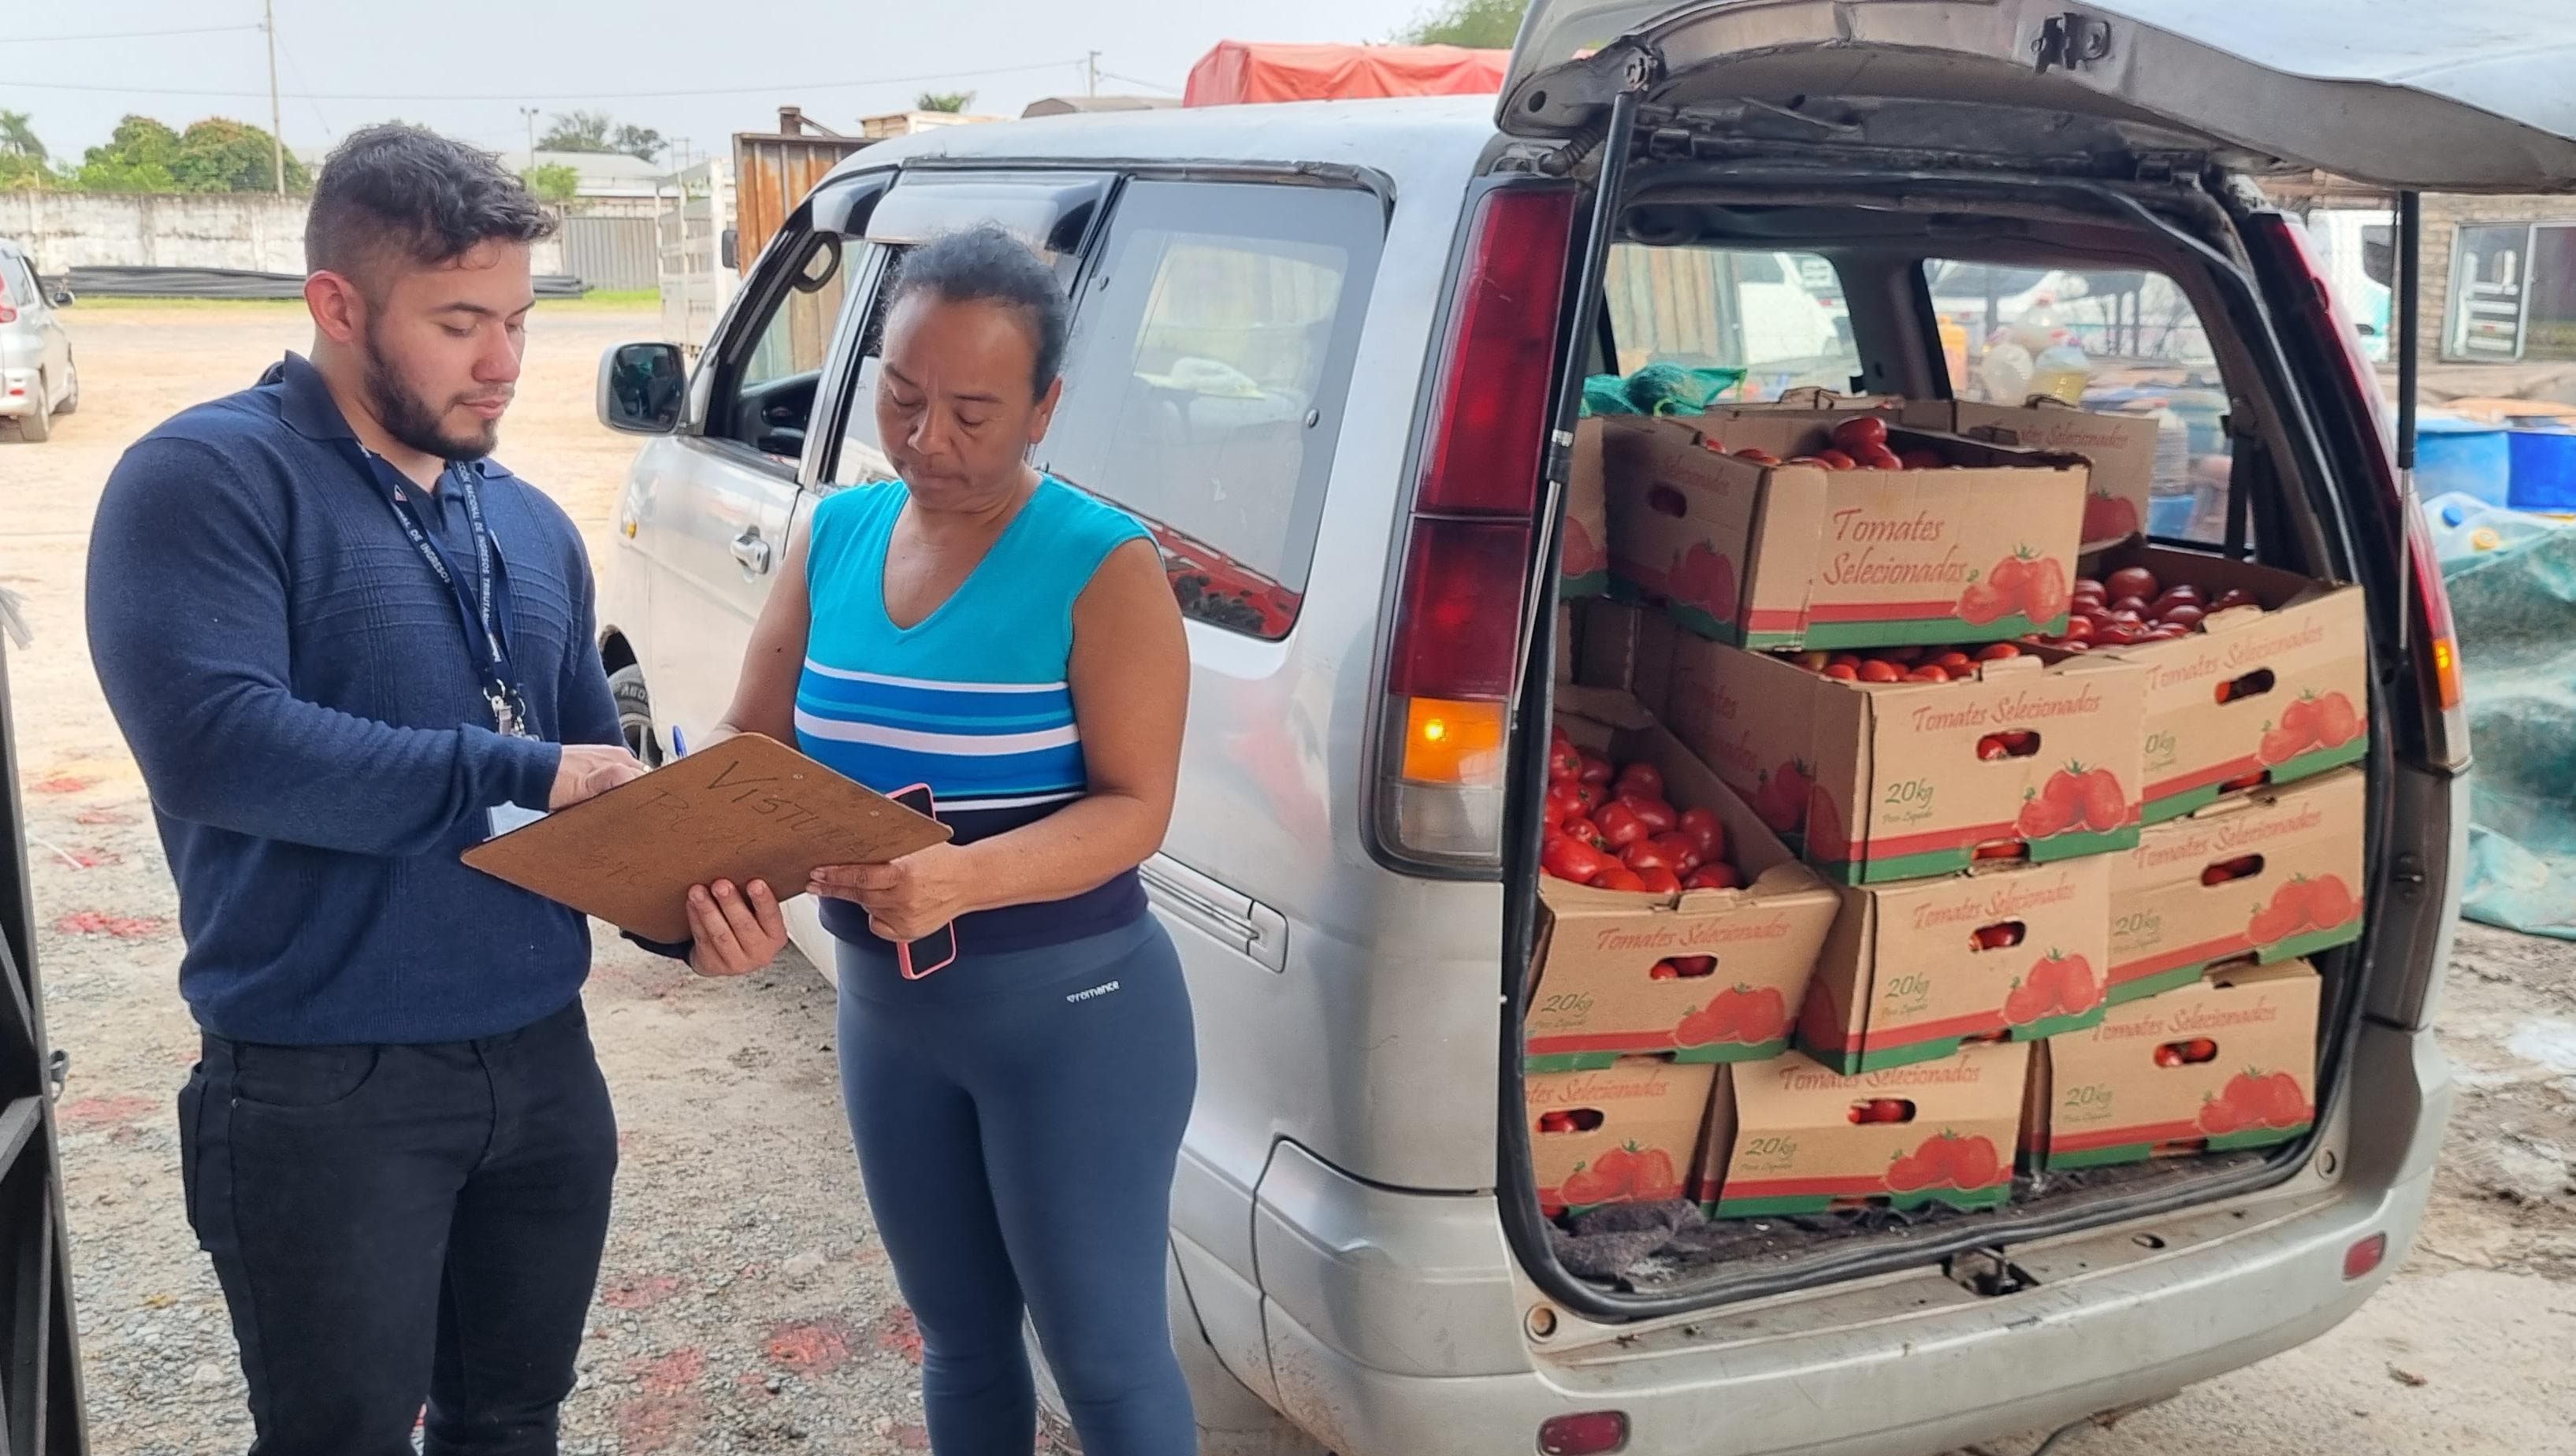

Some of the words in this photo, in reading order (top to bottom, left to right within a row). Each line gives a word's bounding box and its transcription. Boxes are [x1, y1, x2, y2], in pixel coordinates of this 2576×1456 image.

[408, 527, 422, 544] DE
[1833, 507, 1945, 542] Tomates
[1822, 544, 1968, 586] Selecionados
[1912, 702, 1986, 733] Tomates
[1991, 682, 2104, 723] Selecionados
[1884, 778, 1934, 810] 20kg
[1912, 897, 1982, 930] Tomates
[1597, 925, 1677, 952] Tomates
[1678, 911, 1793, 948] Selecionados
[1884, 971, 1930, 1002] 20kg
[1541, 991, 1595, 1018] 20kg
[1558, 1069, 1671, 1102] Selecionados
[1745, 1135, 1797, 1161] 20kg
